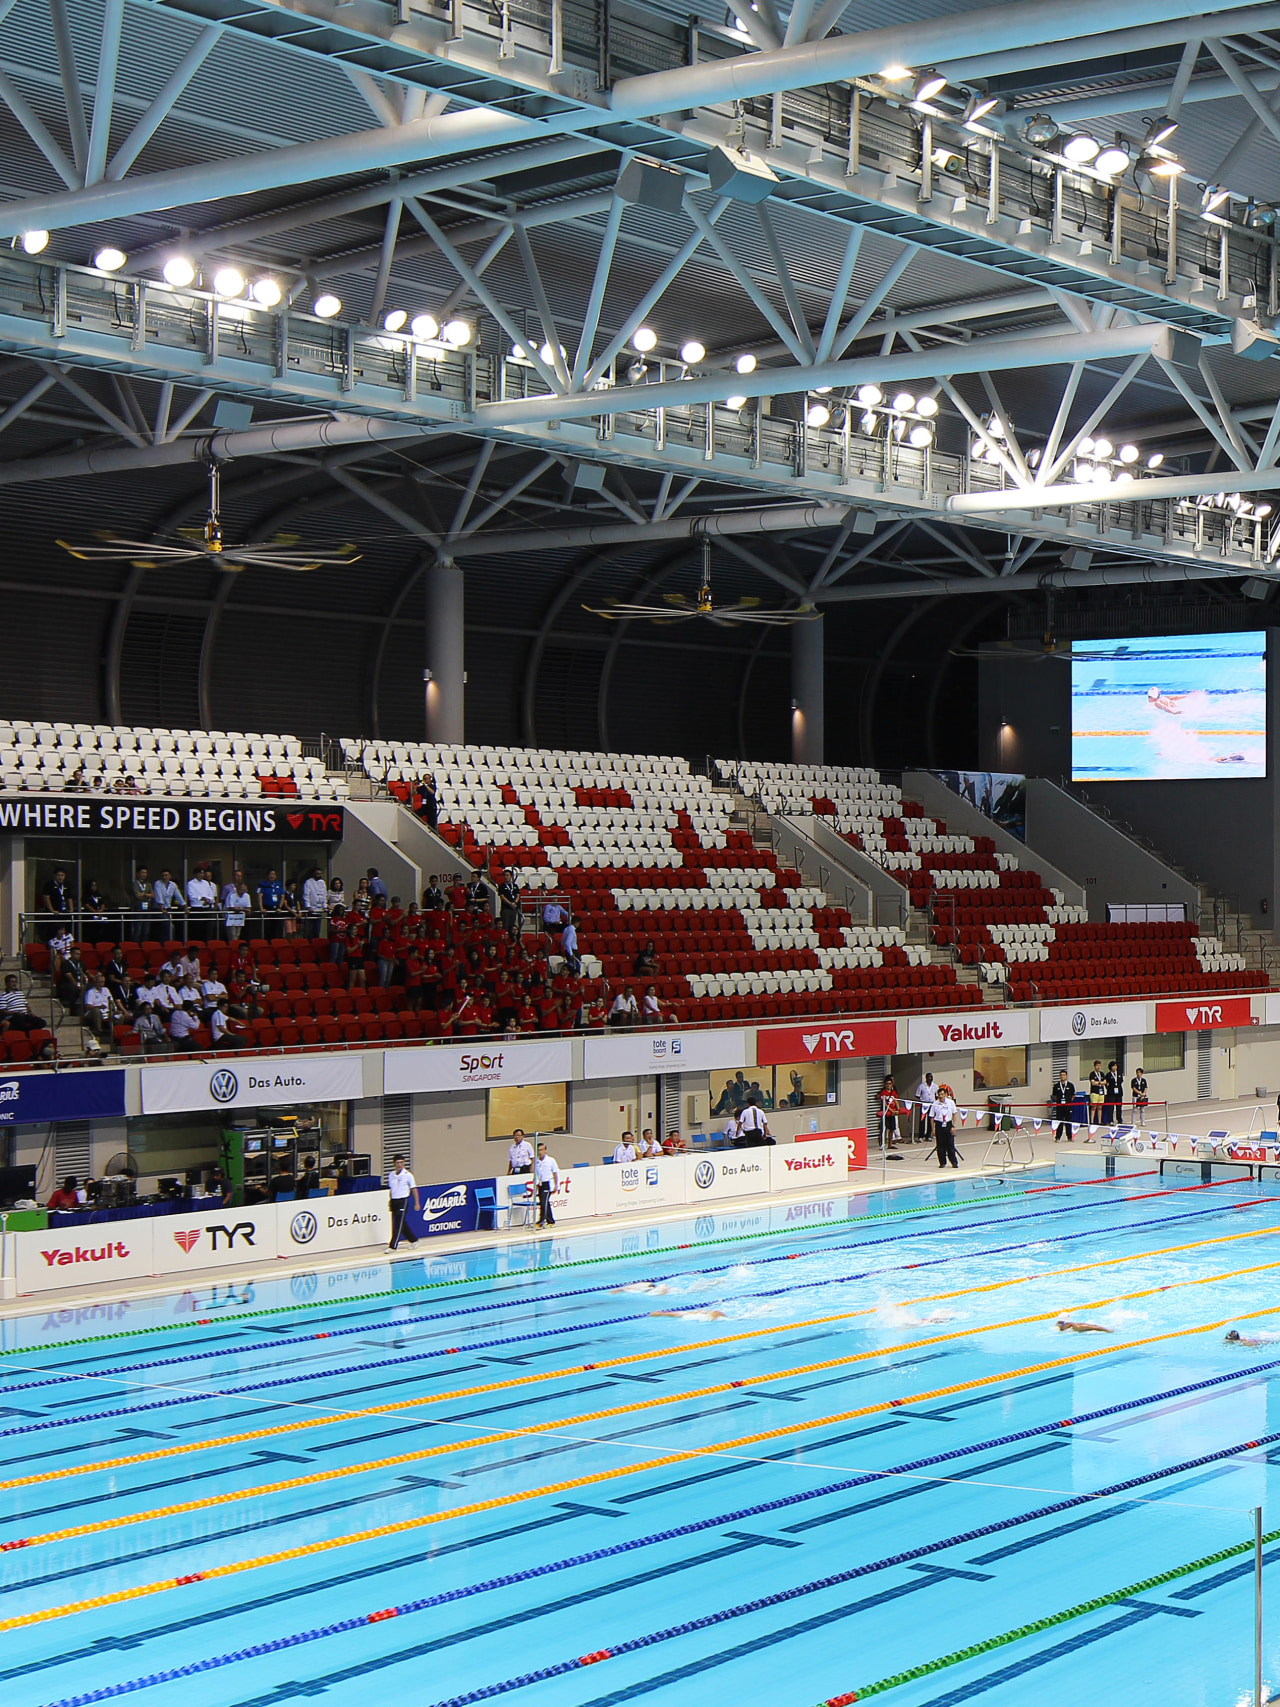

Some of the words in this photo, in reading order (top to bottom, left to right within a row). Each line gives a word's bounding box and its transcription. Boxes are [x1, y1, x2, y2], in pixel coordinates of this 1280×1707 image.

[0, 803, 91, 828] WHERE
[100, 805, 180, 830] SPEED
[188, 808, 276, 832] BEGINS
[308, 813, 342, 832] TYR
[1090, 1017, 1102, 1026] Das
[1103, 1016, 1119, 1026] Auto.
[1199, 1006, 1222, 1024] TYR
[938, 1021, 1003, 1042] Yakult
[821, 1030, 855, 1053] TYR
[459, 1052, 504, 1074] Sport
[248, 1077, 270, 1089] Das
[274, 1075, 306, 1088] Auto.
[462, 1072, 502, 1083] SINGAPORE
[722, 1164, 738, 1176] Das
[740, 1162, 762, 1174] Auto.
[784, 1153, 835, 1171] Yakult
[621, 1168, 639, 1179] tote
[621, 1177, 639, 1187] board
[423, 1194, 467, 1211] AQUARIUS
[327, 1216, 348, 1229] Das
[351, 1213, 382, 1226] Auto.
[428, 1220, 462, 1233] ISOTONIC
[205, 1221, 257, 1251] TYR
[40, 1241, 130, 1267] Yakult
